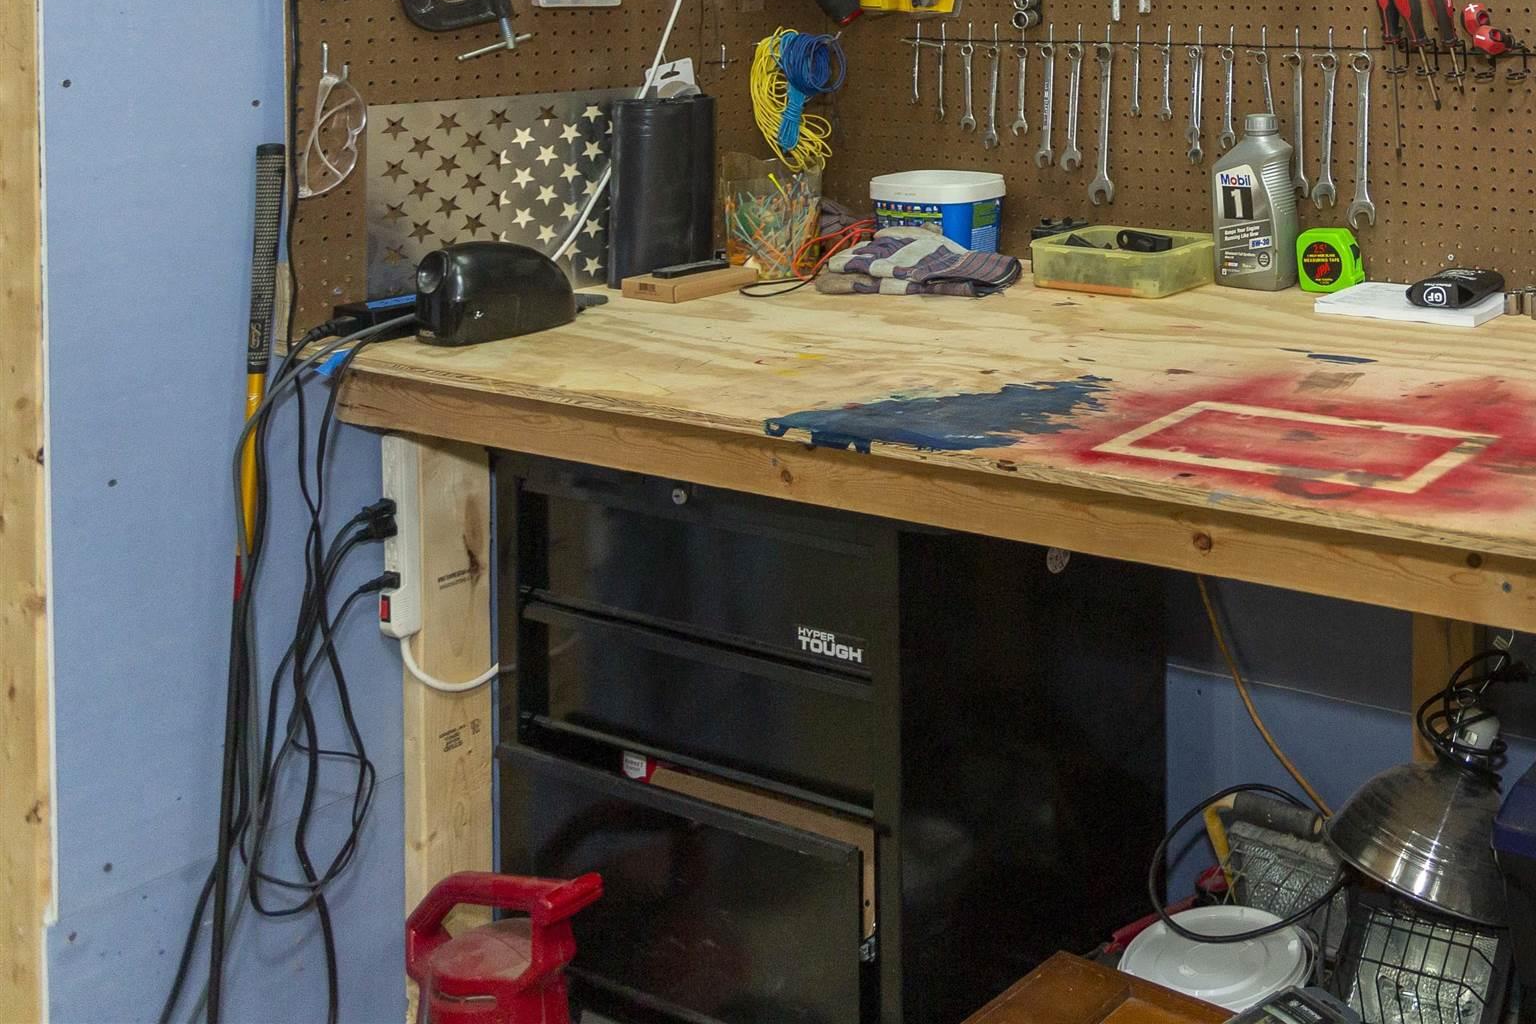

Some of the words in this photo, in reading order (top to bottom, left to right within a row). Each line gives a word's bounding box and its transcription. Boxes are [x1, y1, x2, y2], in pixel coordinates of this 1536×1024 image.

[1220, 174, 1251, 186] Mobil
[1230, 188, 1243, 218] 1
[1427, 291, 1443, 303] GF
[798, 626, 835, 643] HYPER
[798, 635, 863, 663] TOUGH
